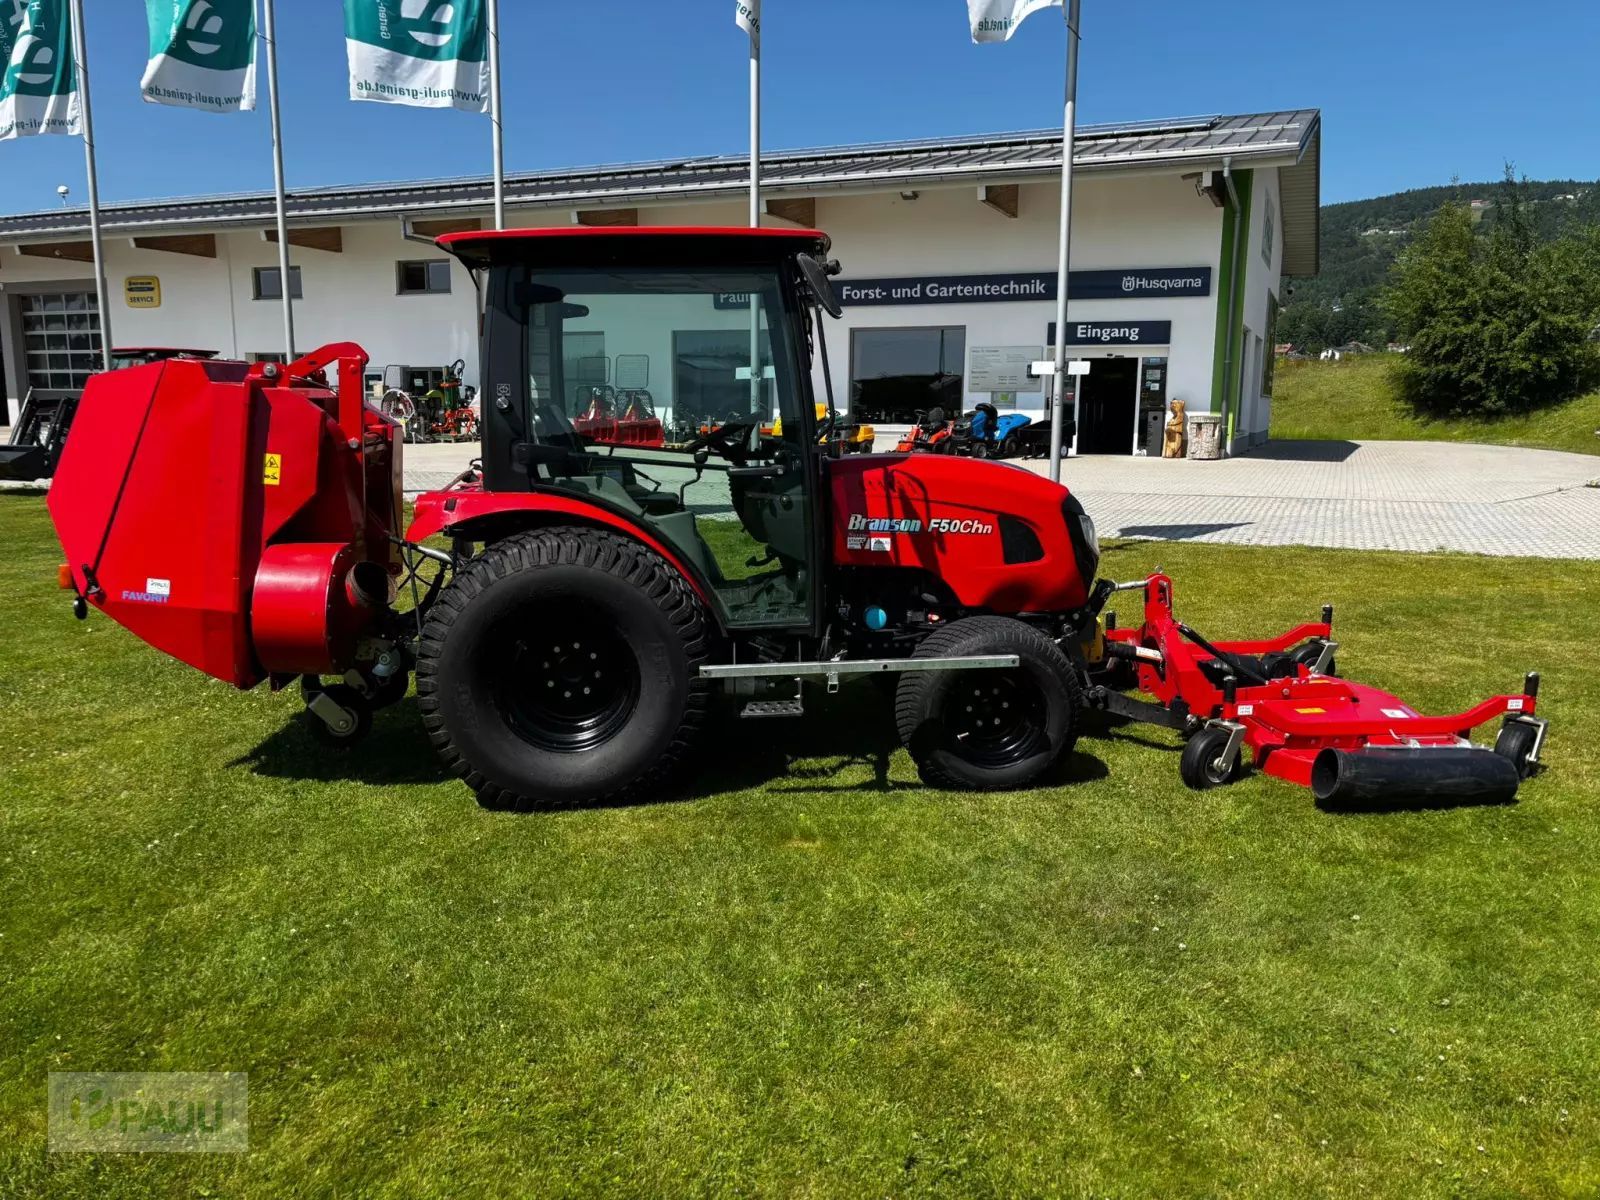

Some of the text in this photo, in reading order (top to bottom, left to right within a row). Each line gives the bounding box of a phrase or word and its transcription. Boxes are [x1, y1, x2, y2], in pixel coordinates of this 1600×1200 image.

[842, 286, 887, 300] Forst-
[892, 284, 921, 298] und
[926, 279, 1046, 298] Gartentechnik
[1136, 277, 1202, 291] Husqvarna
[1077, 325, 1140, 341] Eingang
[847, 513, 993, 534] Branson F50Chn
